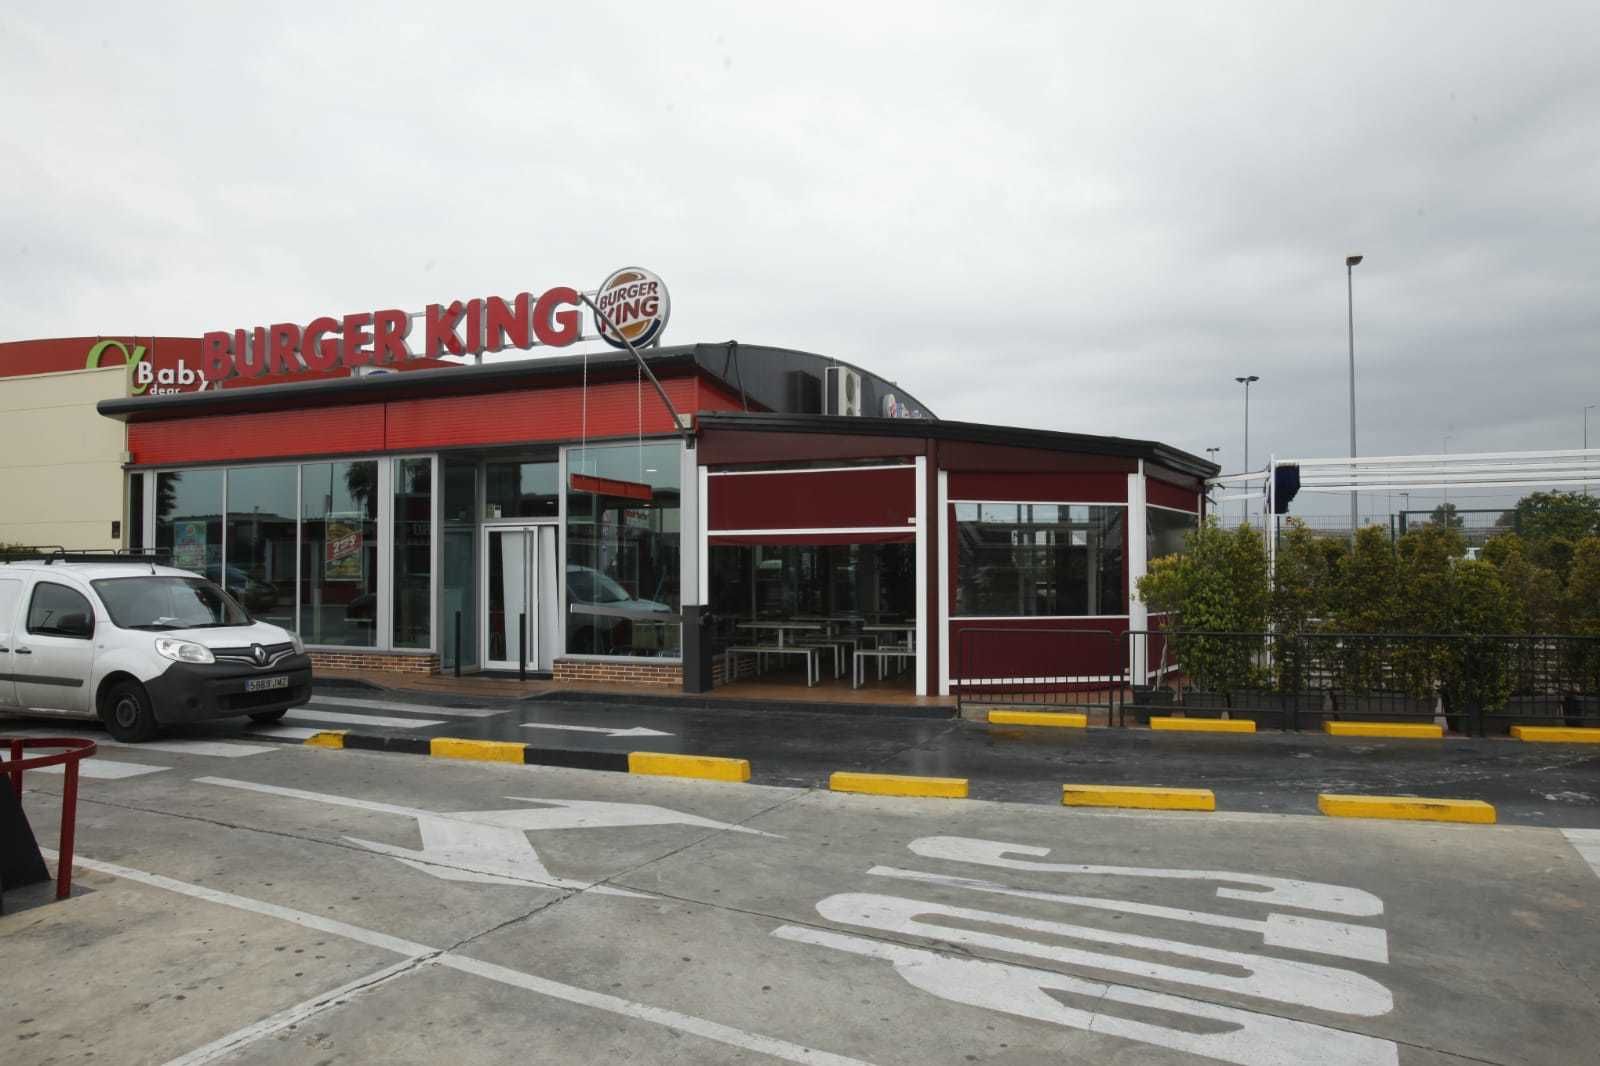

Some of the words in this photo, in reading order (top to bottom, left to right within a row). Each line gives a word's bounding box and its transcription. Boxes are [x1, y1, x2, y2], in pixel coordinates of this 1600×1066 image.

[204, 309, 413, 381] BURGER
[426, 286, 582, 358] KING
[600, 282, 658, 310] BURGER
[773, 835, 1397, 1066] STOP
